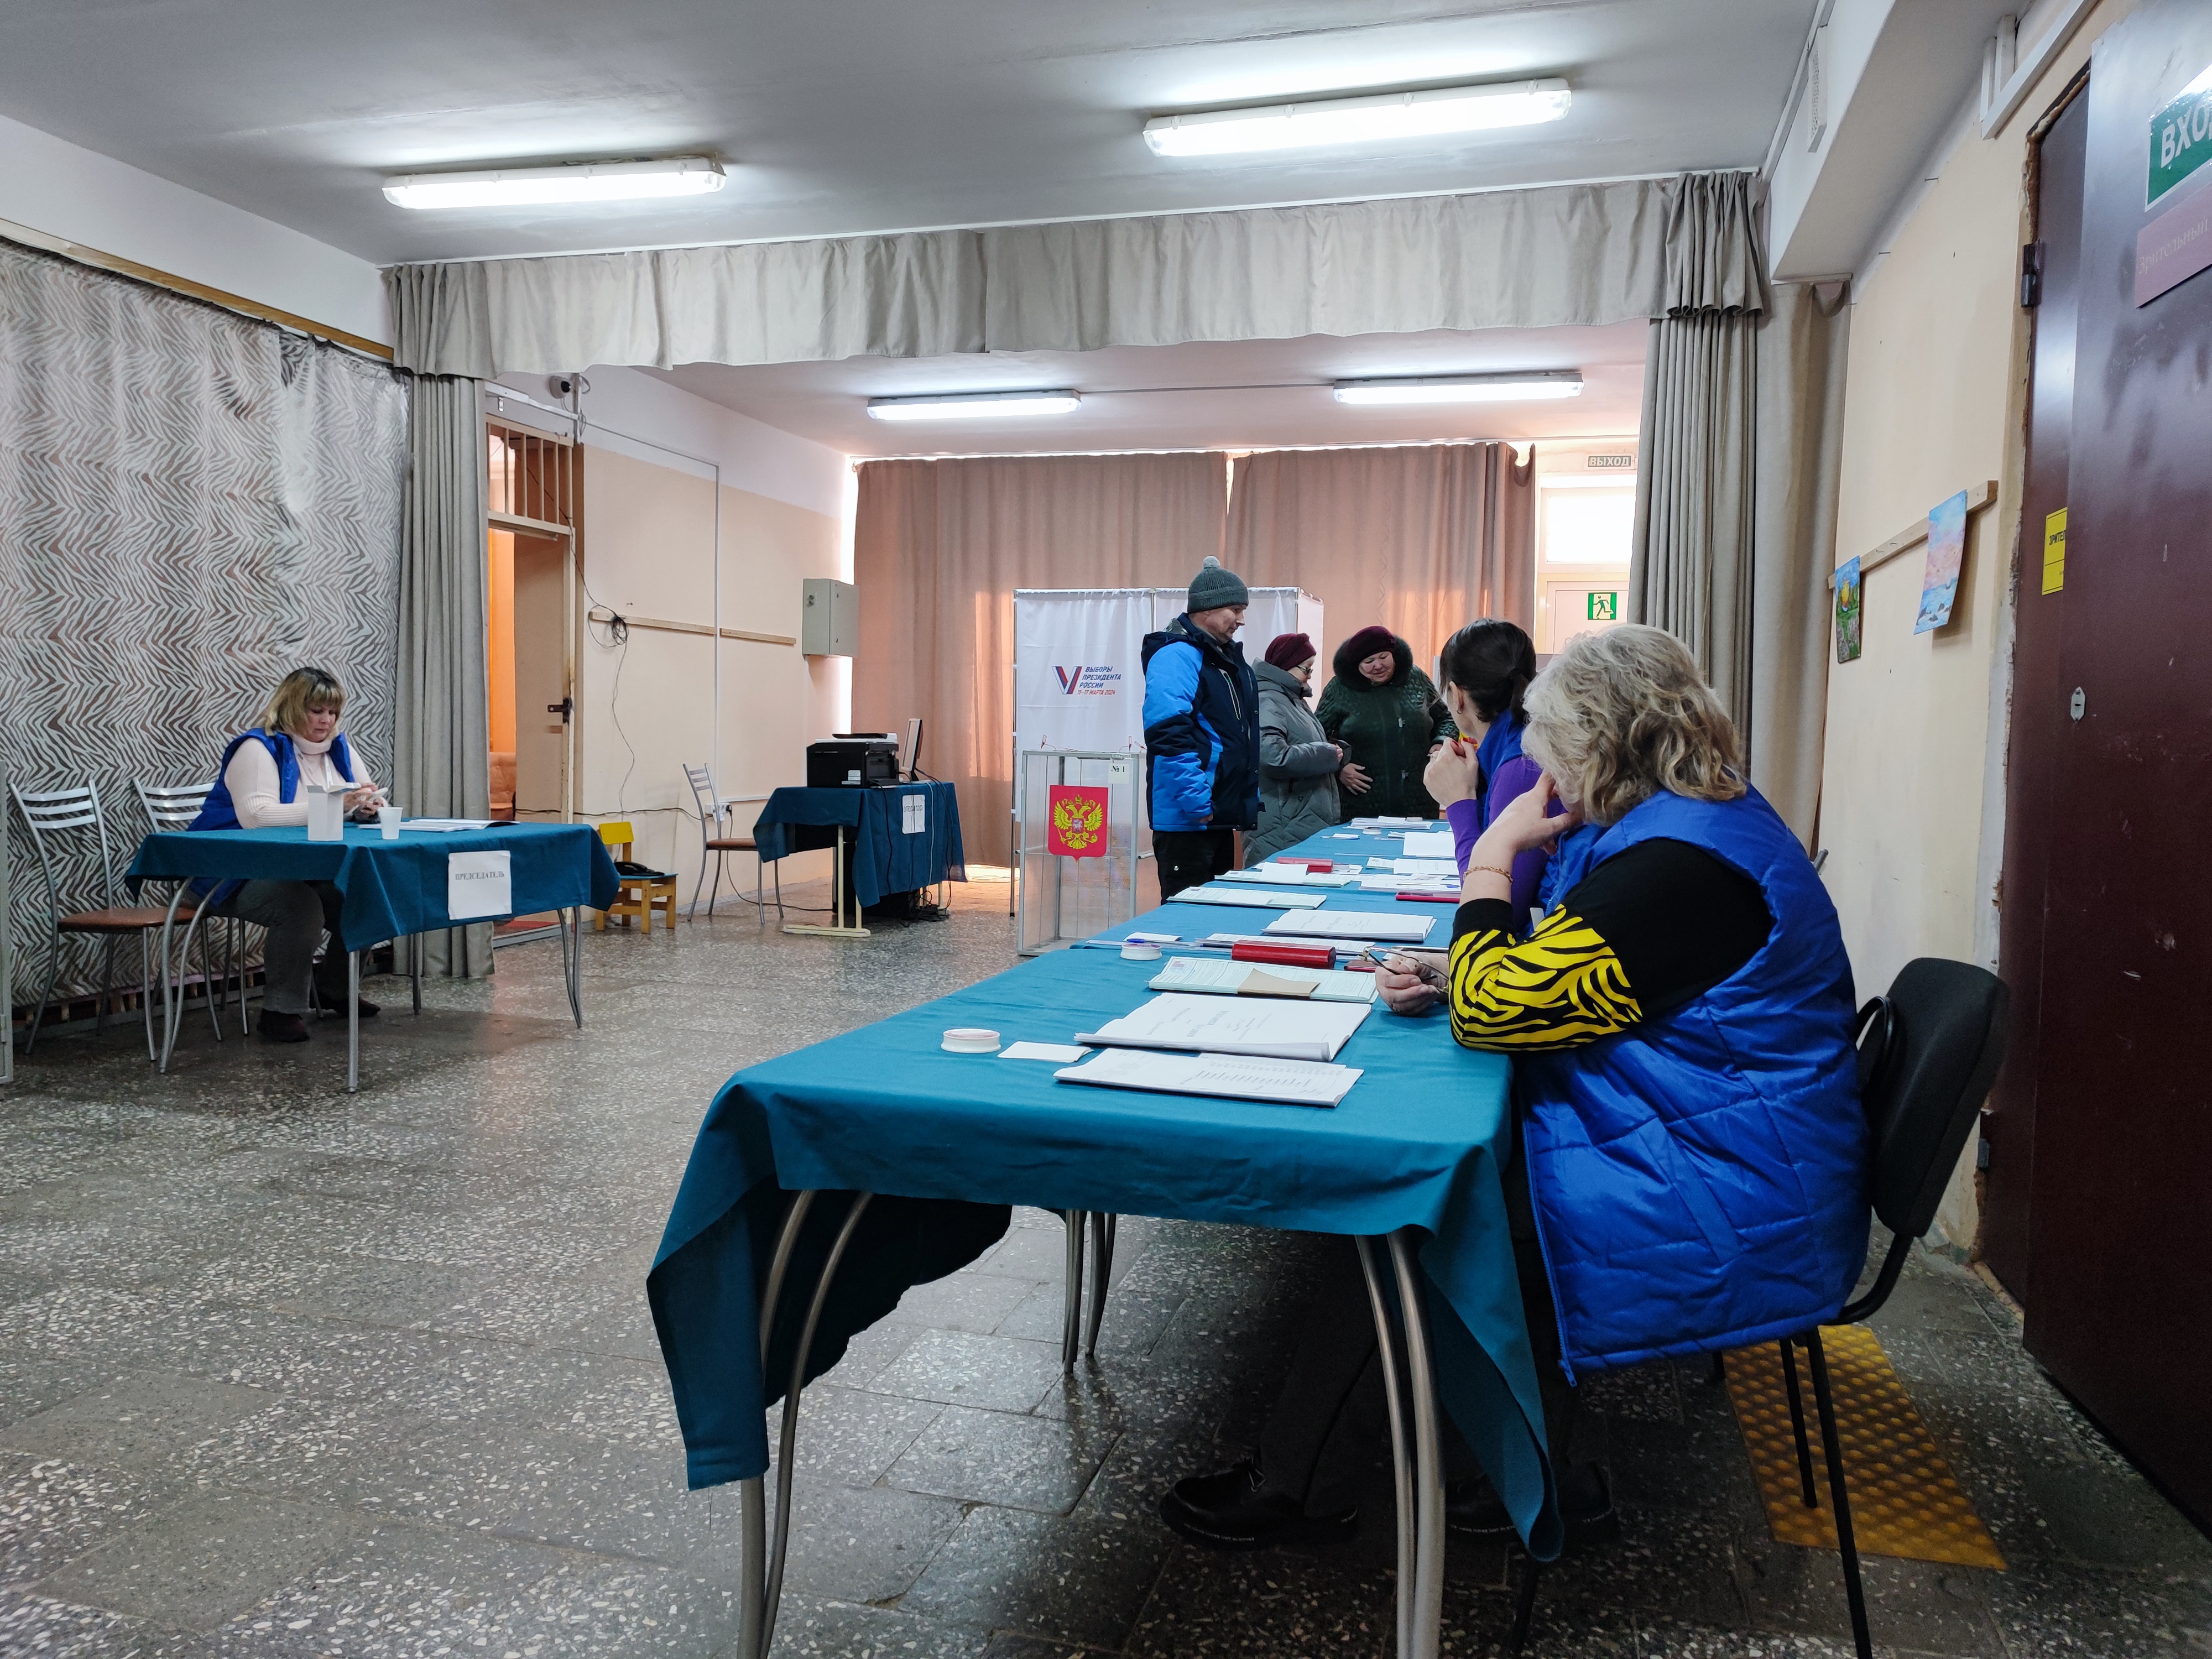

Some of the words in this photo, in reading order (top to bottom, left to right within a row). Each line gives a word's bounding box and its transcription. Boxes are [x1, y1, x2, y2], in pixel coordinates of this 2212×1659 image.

[2139, 217, 2208, 274] Зрительный
[1589, 456, 1630, 467] ВЫХОД
[455, 870, 505, 880] ПРЕДСЕДАТЕЛЬ
